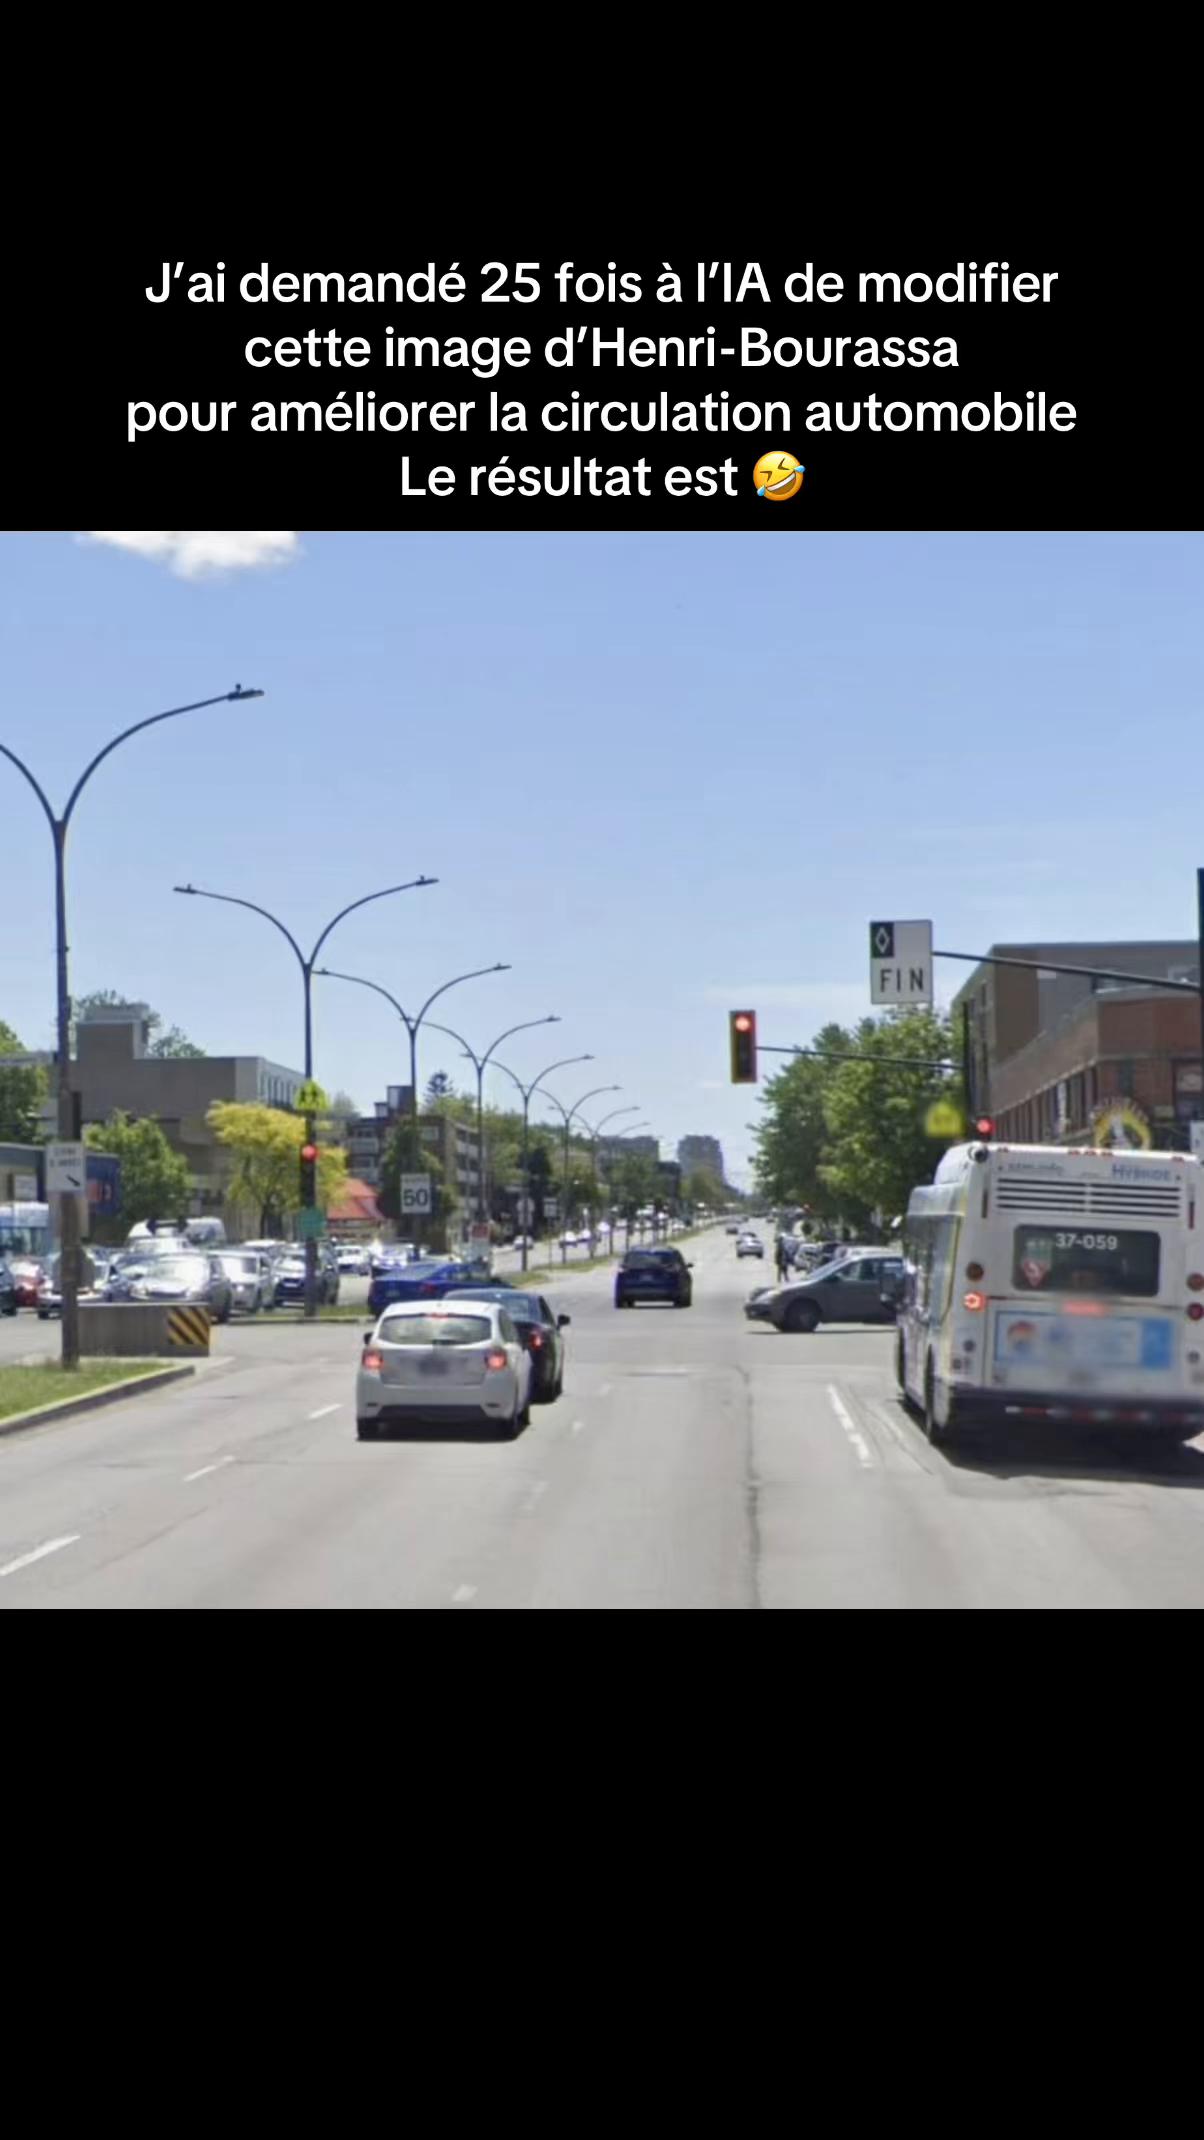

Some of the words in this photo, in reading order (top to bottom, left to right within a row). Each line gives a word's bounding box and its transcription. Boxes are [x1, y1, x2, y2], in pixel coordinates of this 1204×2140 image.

[880, 967, 924, 993] FIN
[403, 1188, 428, 1207] 50
[1055, 1232, 1118, 1250] 37-059
